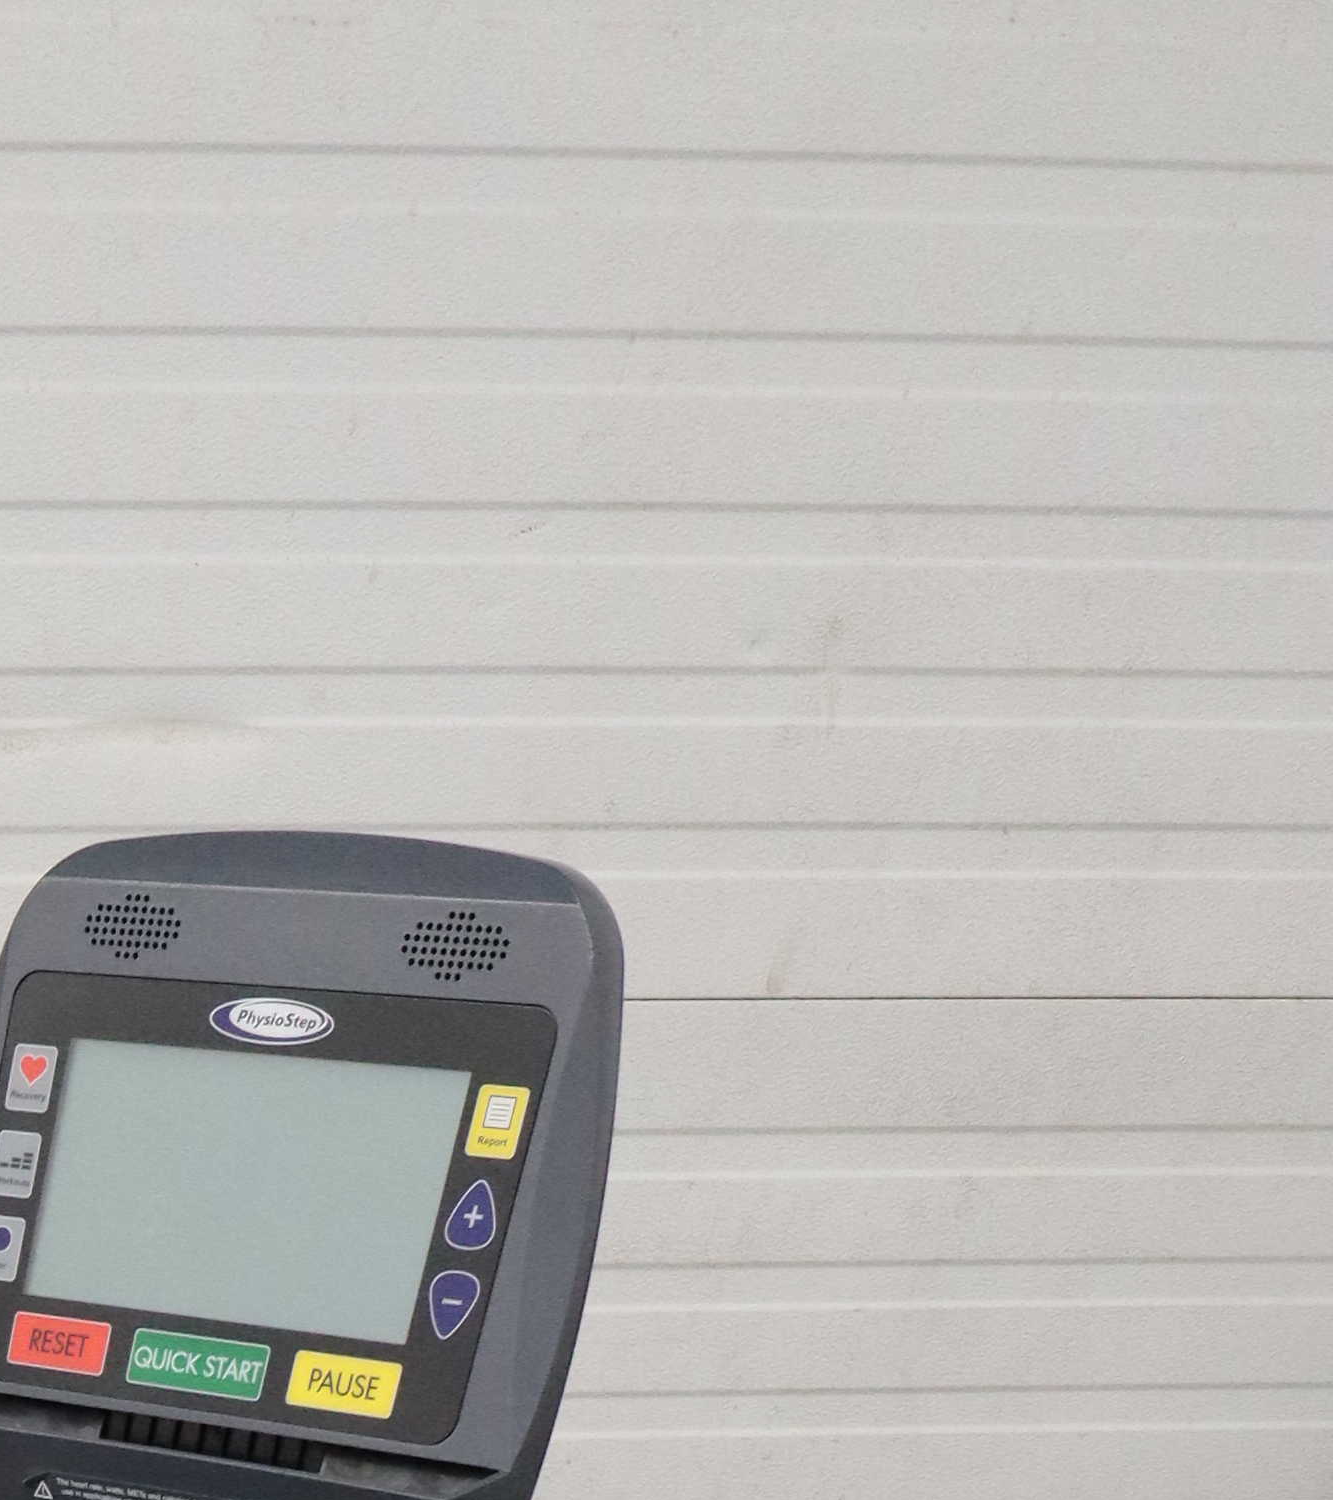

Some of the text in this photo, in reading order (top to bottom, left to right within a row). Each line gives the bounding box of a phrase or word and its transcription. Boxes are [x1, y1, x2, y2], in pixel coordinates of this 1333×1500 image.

[237, 1009, 317, 1033] PhysioStep
[477, 1135, 508, 1149] Report
[28, 1328, 90, 1359] RESET
[133, 1345, 265, 1386] QUICK START
[307, 1368, 381, 1402] PAUSE
